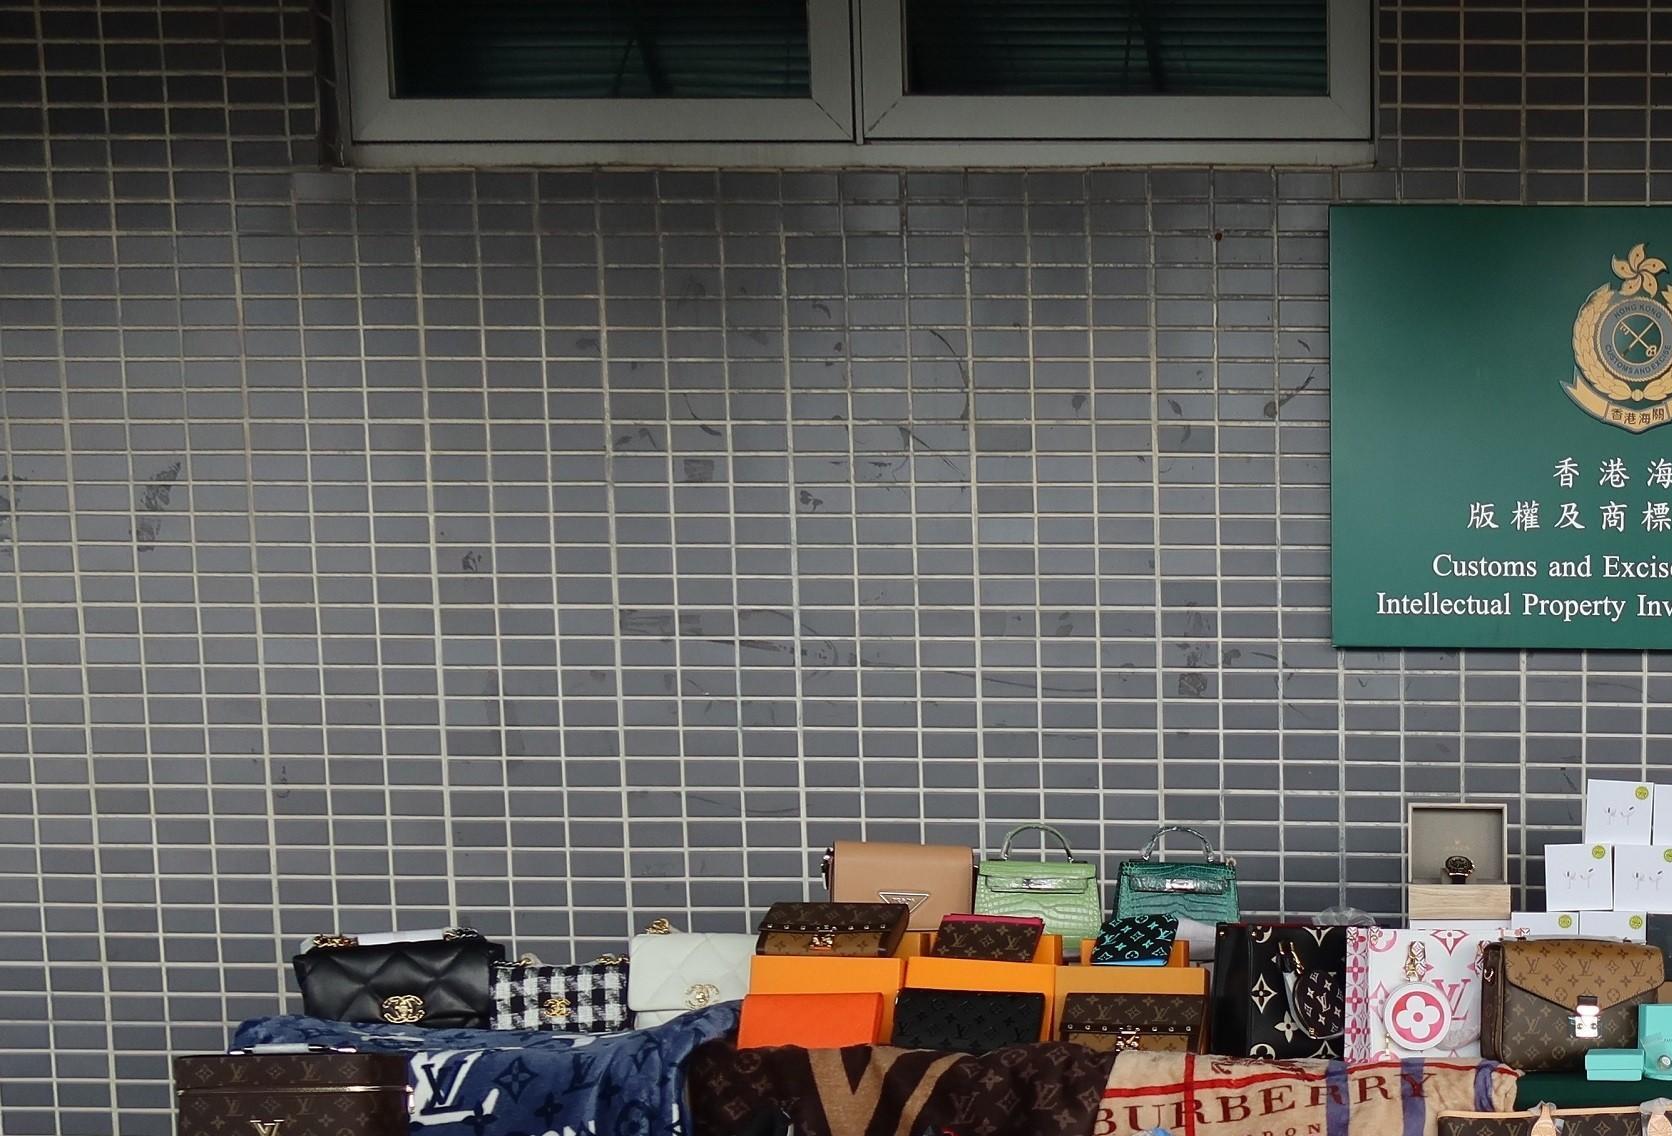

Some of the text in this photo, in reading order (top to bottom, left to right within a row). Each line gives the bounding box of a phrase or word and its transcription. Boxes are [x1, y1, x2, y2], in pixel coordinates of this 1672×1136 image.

[1613, 304, 1664, 318] HONG KONG
[1605, 344, 1671, 375] CUSTOMS AND EXCISE
[1611, 408, 1664, 425] 香港海關
[1433, 554, 1537, 577] Customs
[1548, 555, 1592, 578] and
[1376, 592, 1511, 616] Intellectual
[1523, 594, 1626, 622] Property
[1091, 1072, 1437, 1136] BURBERRY
